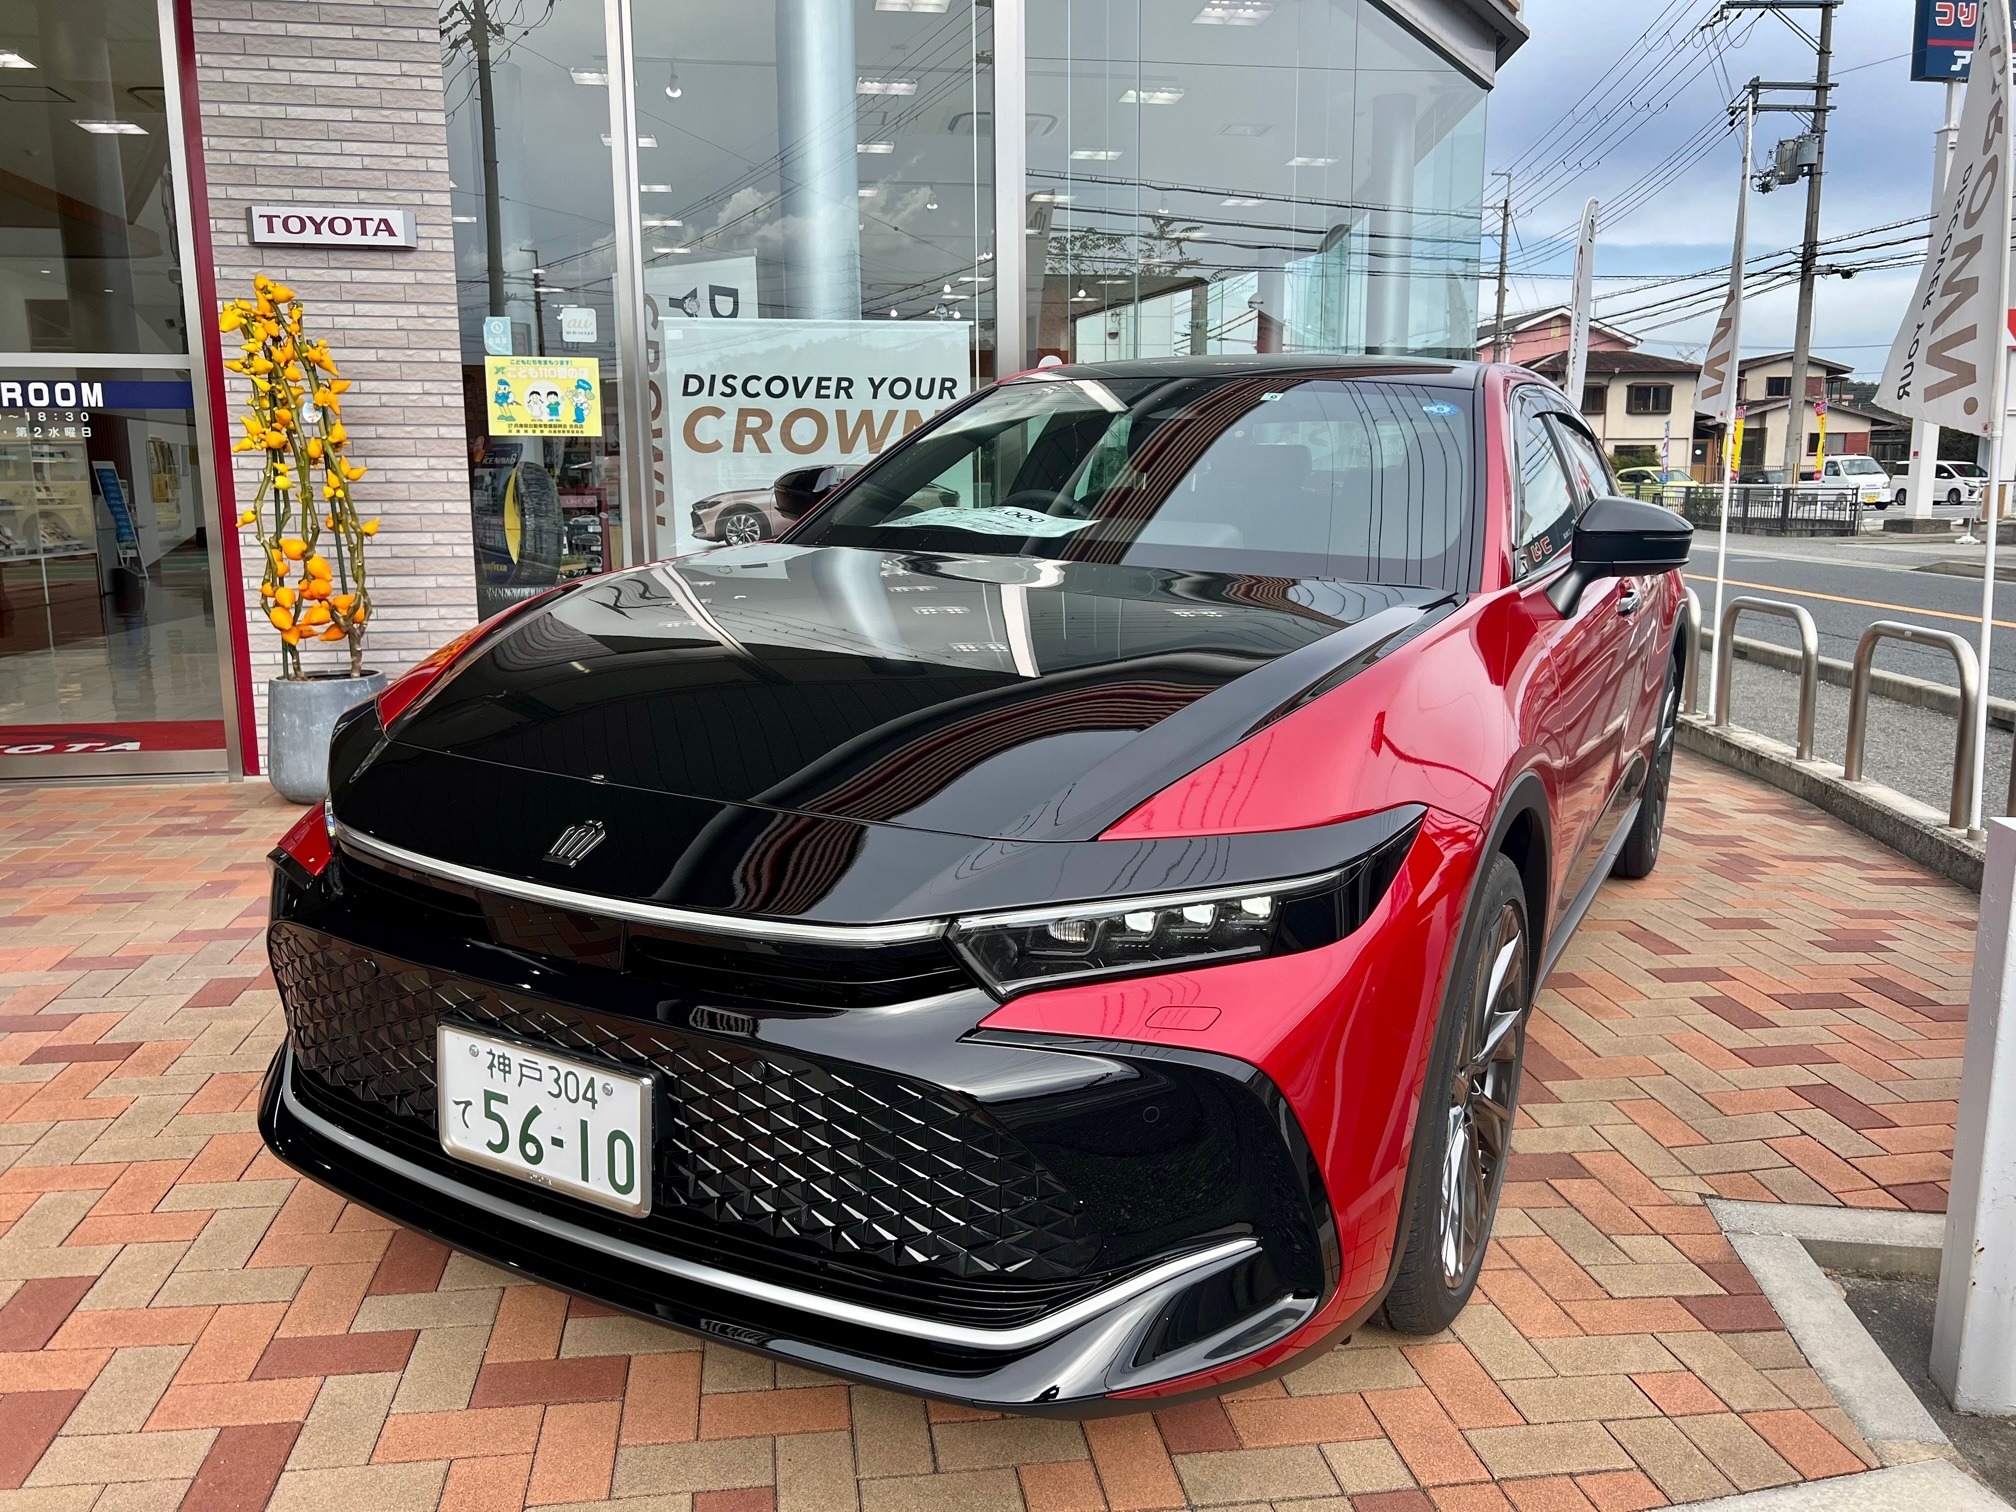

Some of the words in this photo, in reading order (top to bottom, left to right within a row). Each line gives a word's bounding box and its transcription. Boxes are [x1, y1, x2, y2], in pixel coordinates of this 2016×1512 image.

[258, 214, 398, 238] TOYOTA
[567, 318, 593, 329] au
[0, 382, 104, 407] ROOM
[682, 373, 854, 399] DISCOVER
[868, 376, 959, 400] YOUR
[483, 1088, 635, 1196] 56-10
